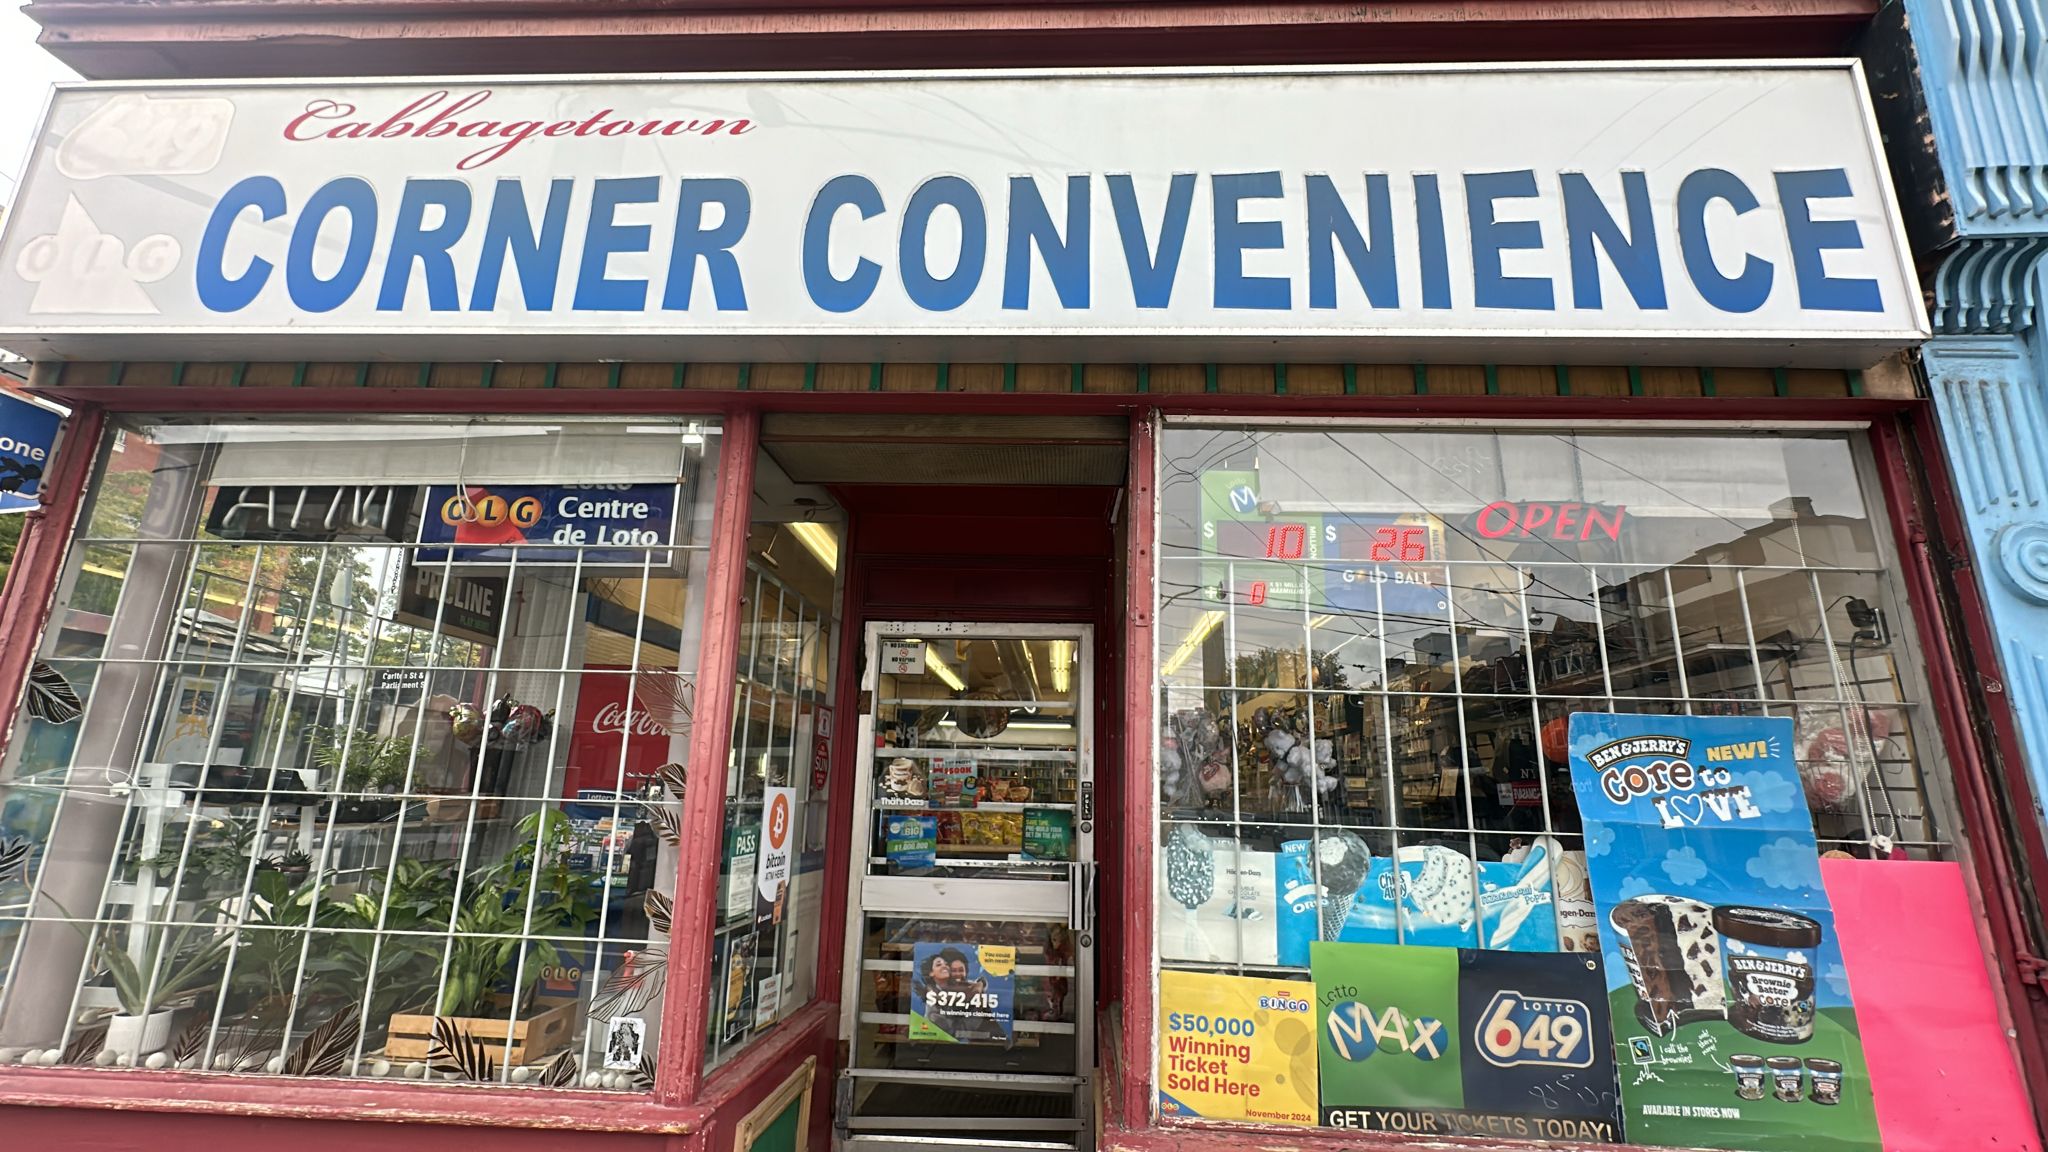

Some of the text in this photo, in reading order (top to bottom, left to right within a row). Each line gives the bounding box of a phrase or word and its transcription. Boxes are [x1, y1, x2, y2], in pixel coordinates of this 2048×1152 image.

[284, 90, 757, 170] Cabbagetown
[196, 168, 1886, 313] CORNER CONVENIENCE
[0, 437, 45, 460] one
[444, 497, 538, 525] OLG
[558, 496, 649, 519] Centre
[1476, 500, 1627, 542] OPEN
[553, 523, 659, 546] de Loto
[1266, 524, 1305, 559] 10
[1371, 527, 1425, 561] 26
[1432, 529, 1440, 559] MILLIO
[1394, 570, 1432, 585] BALL
[409, 672, 418, 680] St
[1706, 741, 1768, 762] NEW!
[1697, 765, 1732, 787] to
[736, 835, 756, 855] PASS
[1284, 843, 1306, 853] NEW
[765, 852, 787, 869] bitcoin
[775, 868, 785, 879] HERE
[1226, 868, 1262, 876] Häen-Dazs
[1379, 871, 1406, 889] Chs
[1384, 884, 1407, 899] Ahy
[542, 967, 580, 980] OLG
[1750, 975, 1792, 988] Brownie
[926, 990, 999, 1009] $372,415
[1318, 984, 1358, 1008] Lotto
[1756, 984, 1789, 996] Batter
[946, 1010, 972, 1018] winnings
[1258, 996, 1309, 1012] BINGO
[1522, 1001, 1576, 1014] LOTTO
[1168, 1012, 1255, 1037] $50,000
[1327, 1001, 1443, 1061] MAX
[1484, 999, 1583, 1059] 649
[1168, 1036, 1251, 1064] Winning
[1676, 1043, 1689, 1054] the
[1168, 1054, 1228, 1075] Ticket
[1167, 1073, 1260, 1097] Sold Here
[1246, 1108, 1312, 1122] November 2024
[1642, 1104, 1740, 1119] AVAILABLE IN STORES NOW
[1329, 1109, 1614, 1143] GET YOUR TICKETS TODAY!
